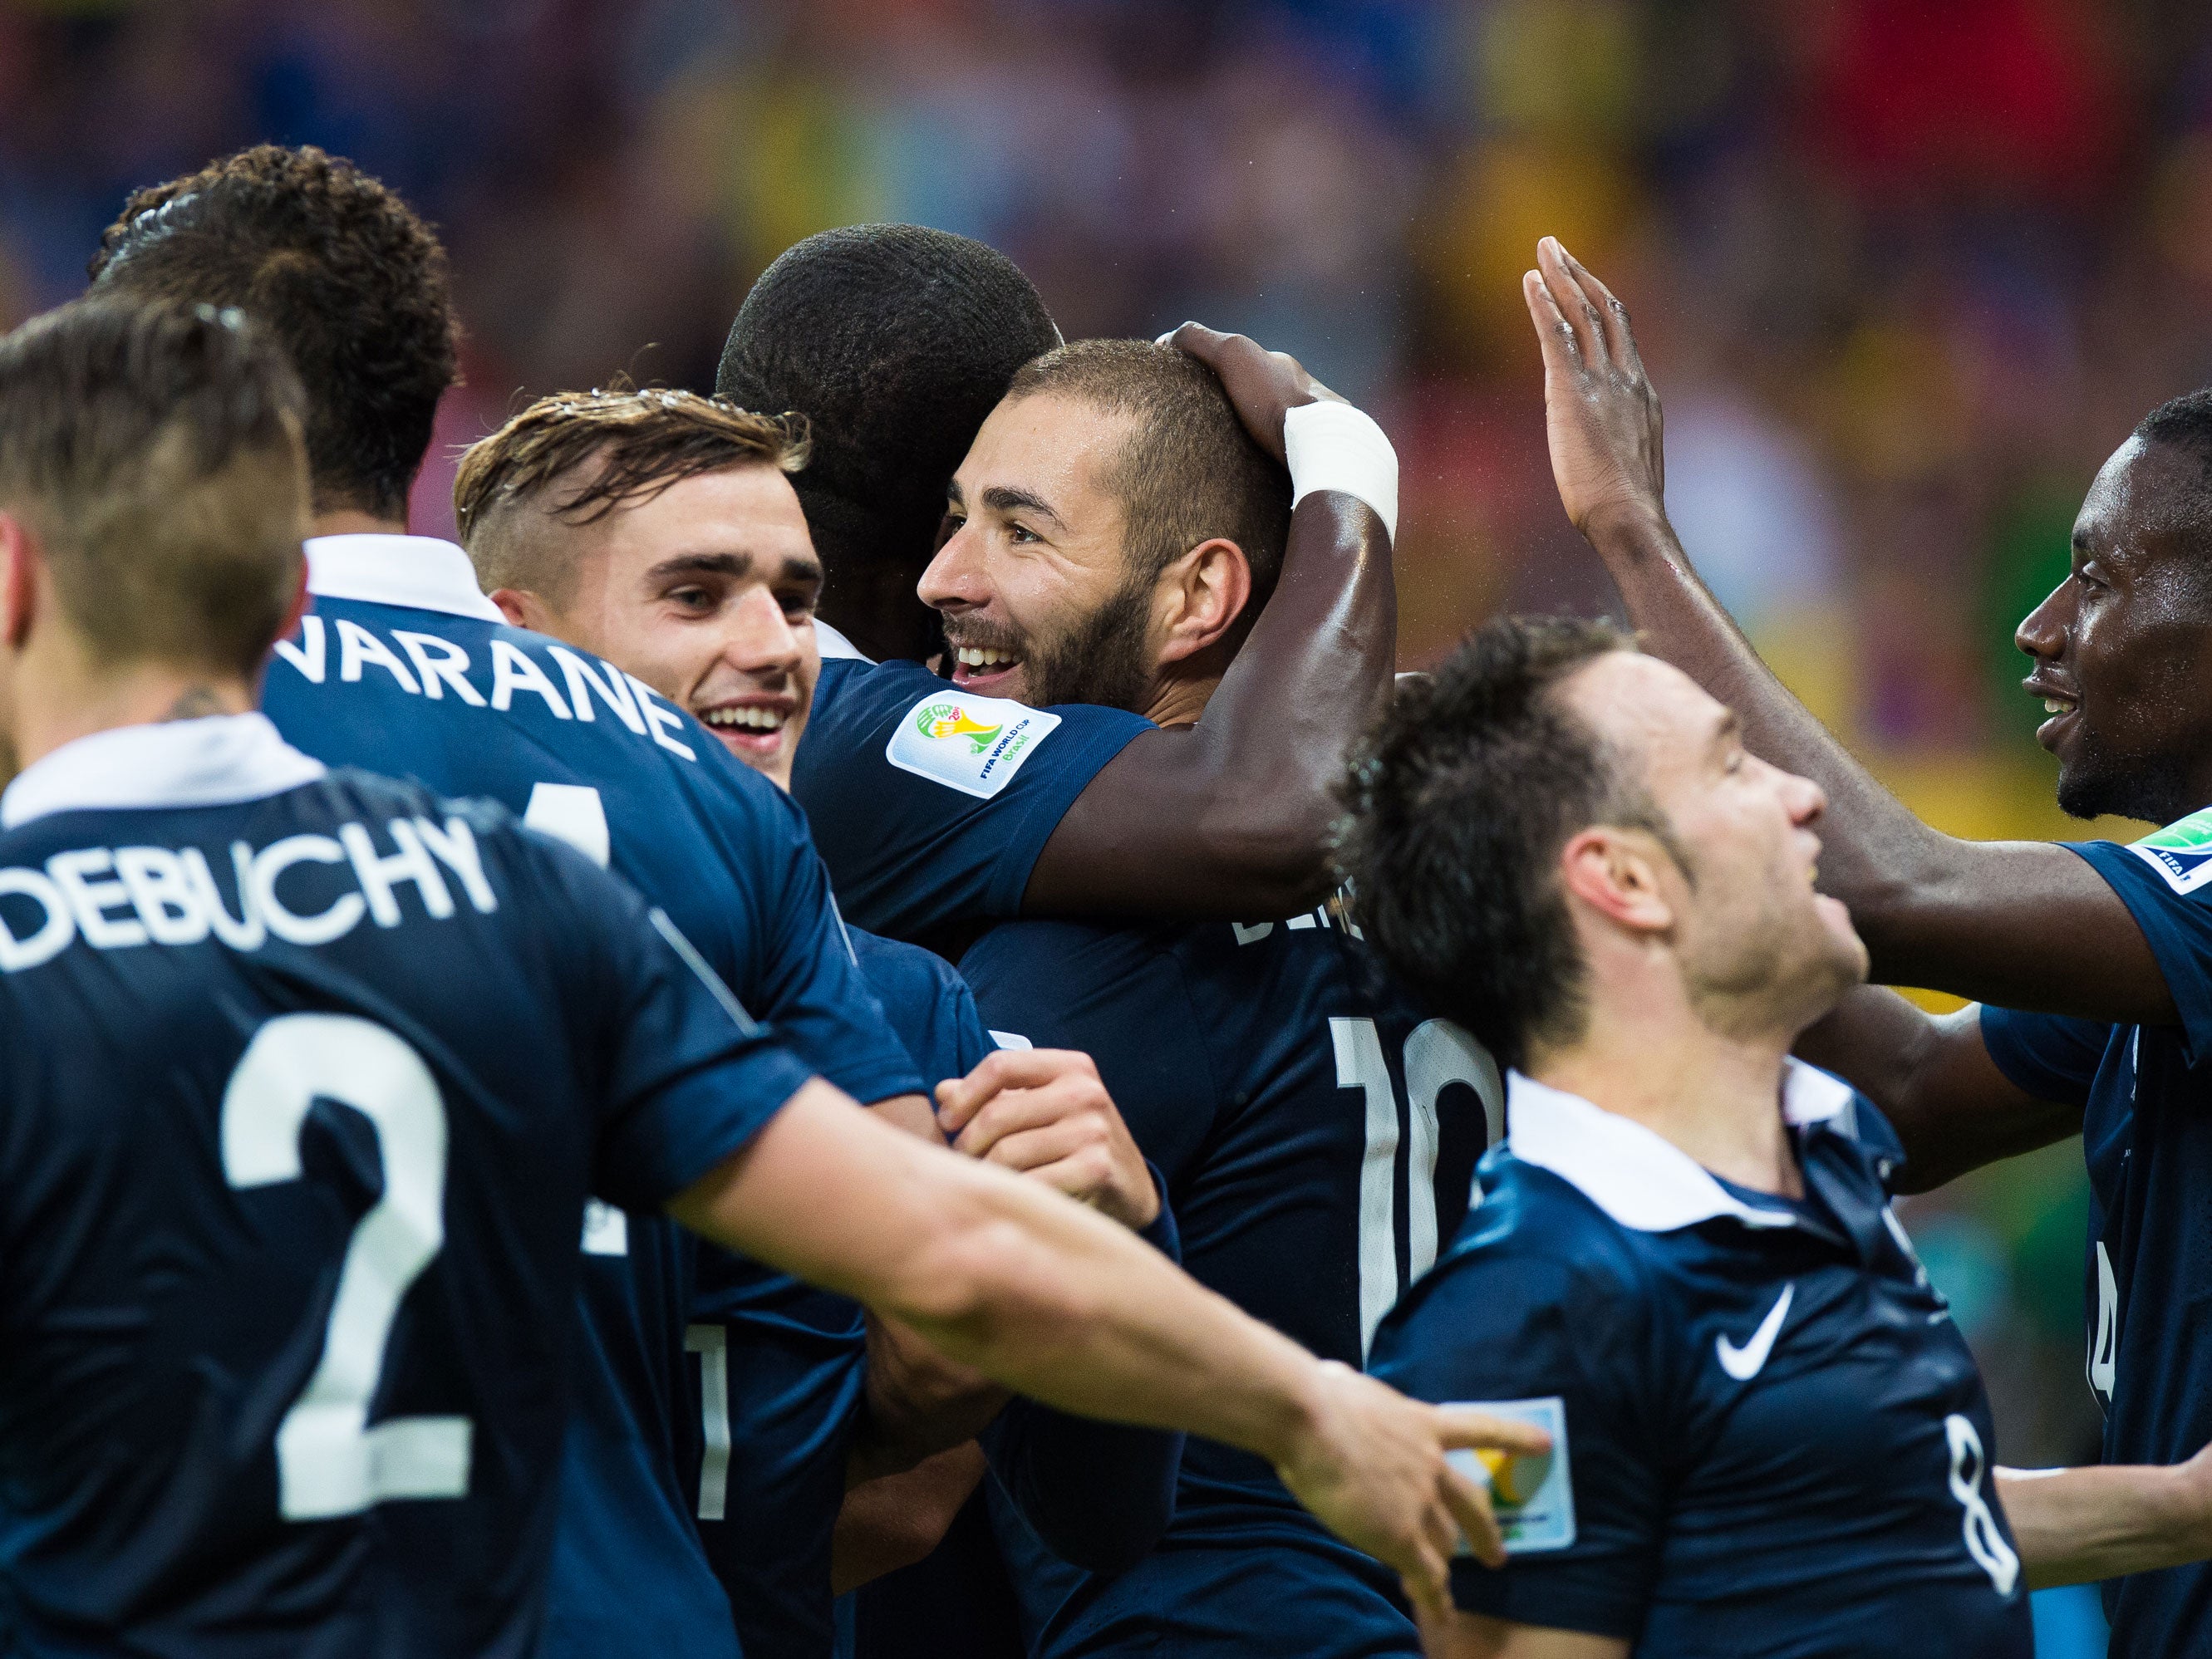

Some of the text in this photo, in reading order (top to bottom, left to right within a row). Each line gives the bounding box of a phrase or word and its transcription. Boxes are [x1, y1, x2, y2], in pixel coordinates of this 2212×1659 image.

[273, 614, 697, 762] VARANE
[980, 719, 1030, 779] FIFA WORLD CUP
[0, 815, 499, 973] DEBUCHY
[2158, 852, 2183, 875] FIFA
[219, 1011, 475, 1523] 2
[1328, 1016, 1504, 1375] 10
[1943, 1413, 2021, 1597] 8
